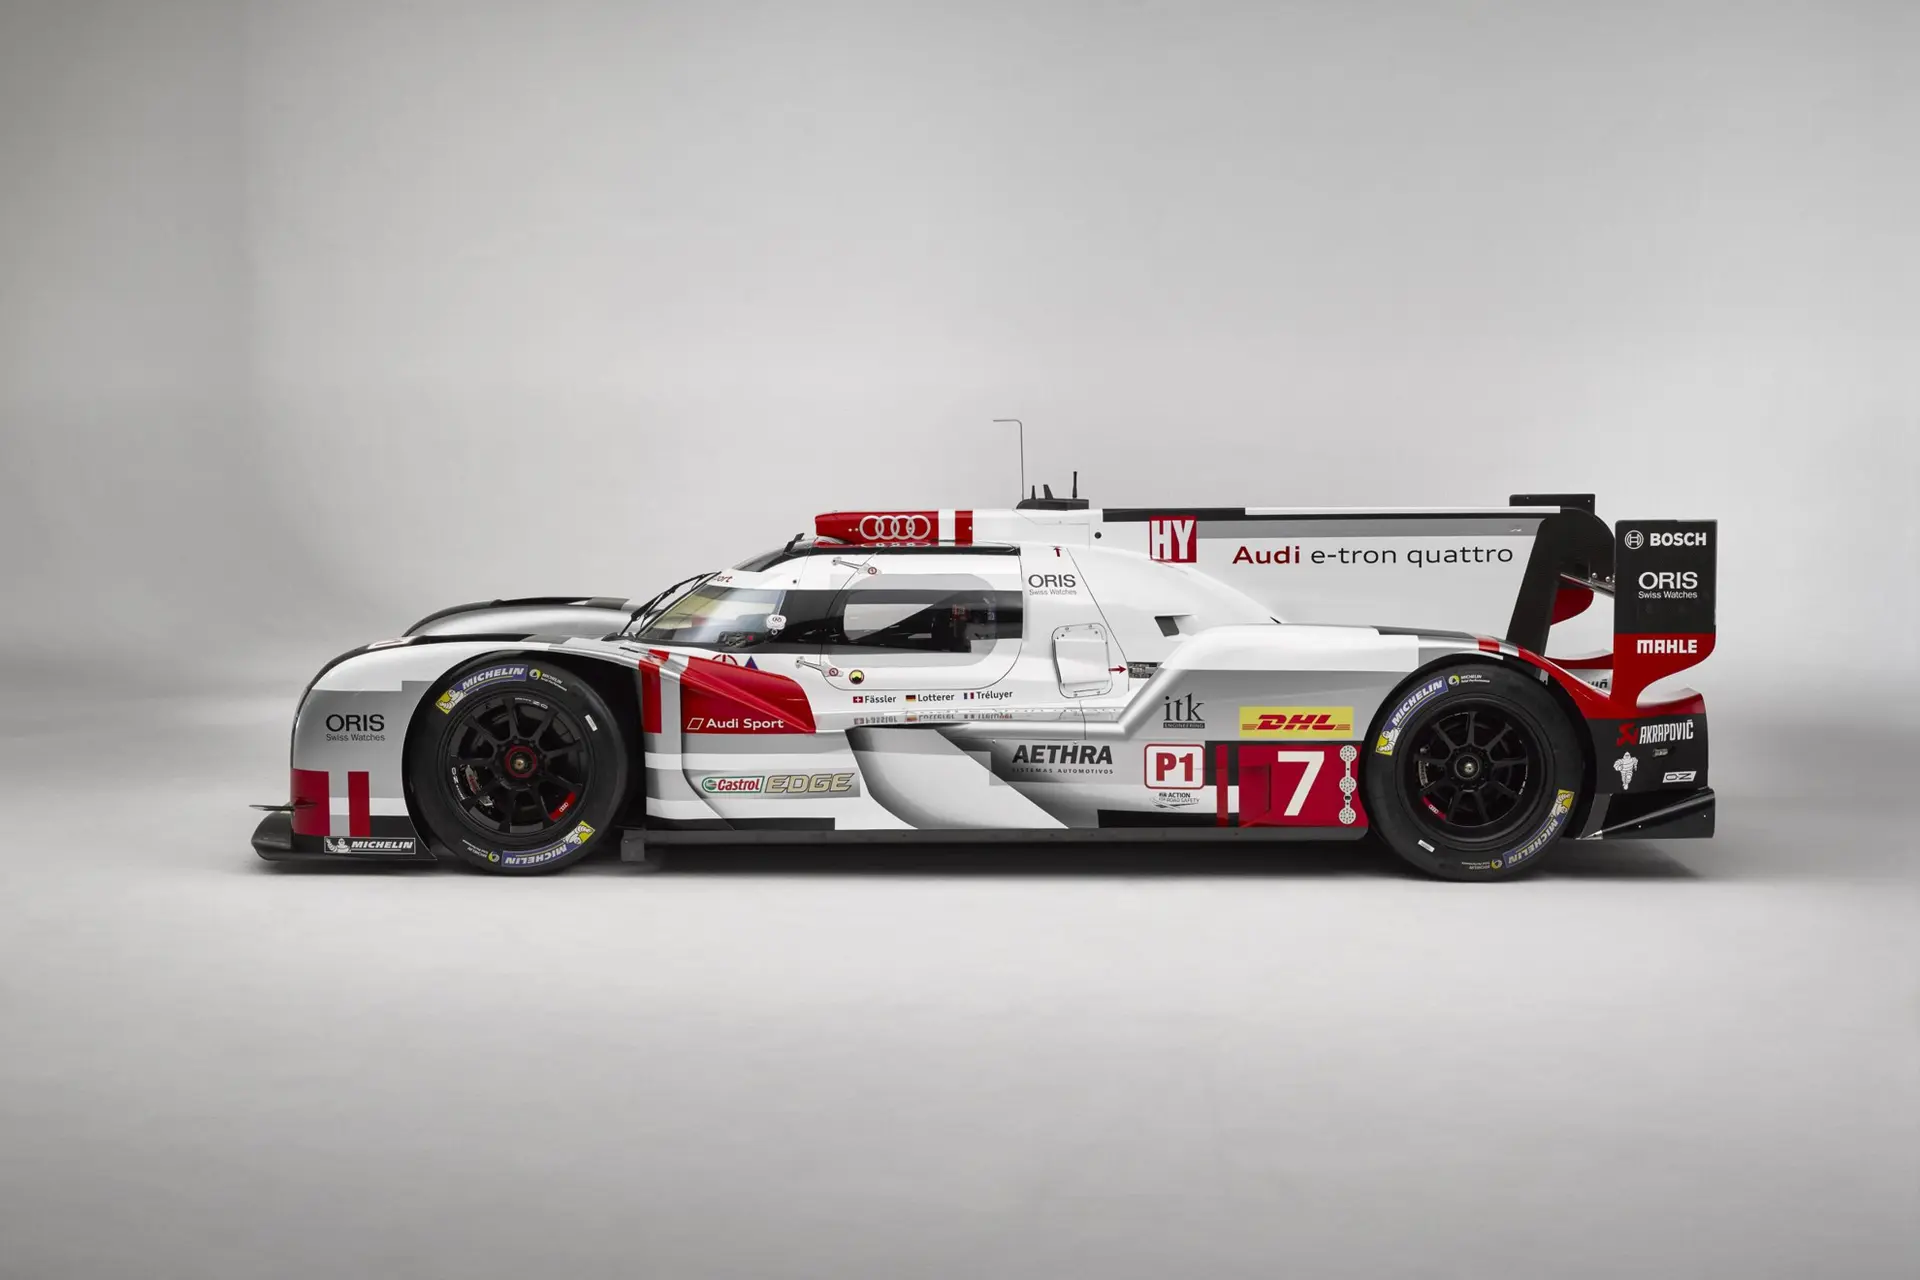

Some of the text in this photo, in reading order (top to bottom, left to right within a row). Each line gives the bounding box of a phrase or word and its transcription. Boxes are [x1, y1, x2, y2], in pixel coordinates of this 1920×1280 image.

[1151, 520, 1195, 560] HY
[1649, 532, 1707, 547] BOSCH
[1232, 546, 1513, 568] Audi e-tron quattro
[1028, 574, 1076, 588] ORIS
[1638, 571, 1698, 590] ORIS
[1049, 588, 1077, 596] Watches
[1638, 591, 1698, 599] Swiss Watches
[1637, 639, 1697, 654] MAHLE
[461, 667, 525, 690] MICHELIN
[865, 690, 1014, 703] Fässler Lotterer Tréluyer
[1391, 680, 1443, 727] MICHELIN
[1163, 693, 1205, 722] itk
[325, 714, 385, 732] ORIS
[706, 719, 784, 730] Audi Sport
[1257, 714, 1336, 731] DHL
[326, 733, 386, 741] Swiss Watches
[1011, 744, 1113, 765] AETHRA
[1156, 752, 1194, 782] P1
[717, 773, 855, 793] Castrol EDGE
[1278, 750, 1325, 816] 7
[351, 840, 413, 849] MICHELIN
[1508, 818, 1560, 865] MICHELIN
[505, 843, 567, 865] MICHELIN
